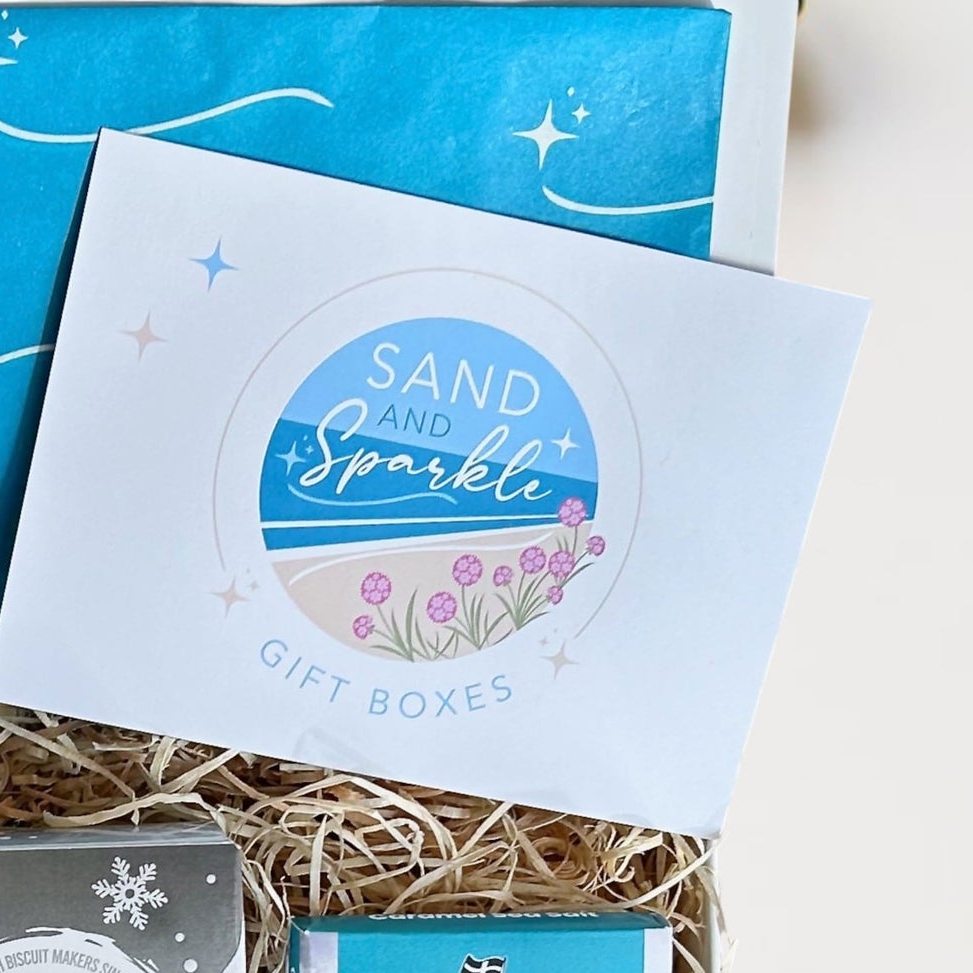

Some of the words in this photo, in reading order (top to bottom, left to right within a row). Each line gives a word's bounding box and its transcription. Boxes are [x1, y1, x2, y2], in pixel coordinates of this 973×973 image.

[366, 342, 541, 417] SAND
[299, 397, 554, 502] Sparkle
[376, 403, 452, 438] AND
[260, 638, 351, 703] GIFT
[368, 675, 513, 719] BOXES
[3, 948, 49, 970] BISCUIT
[52, 949, 101, 973] MAKERS
